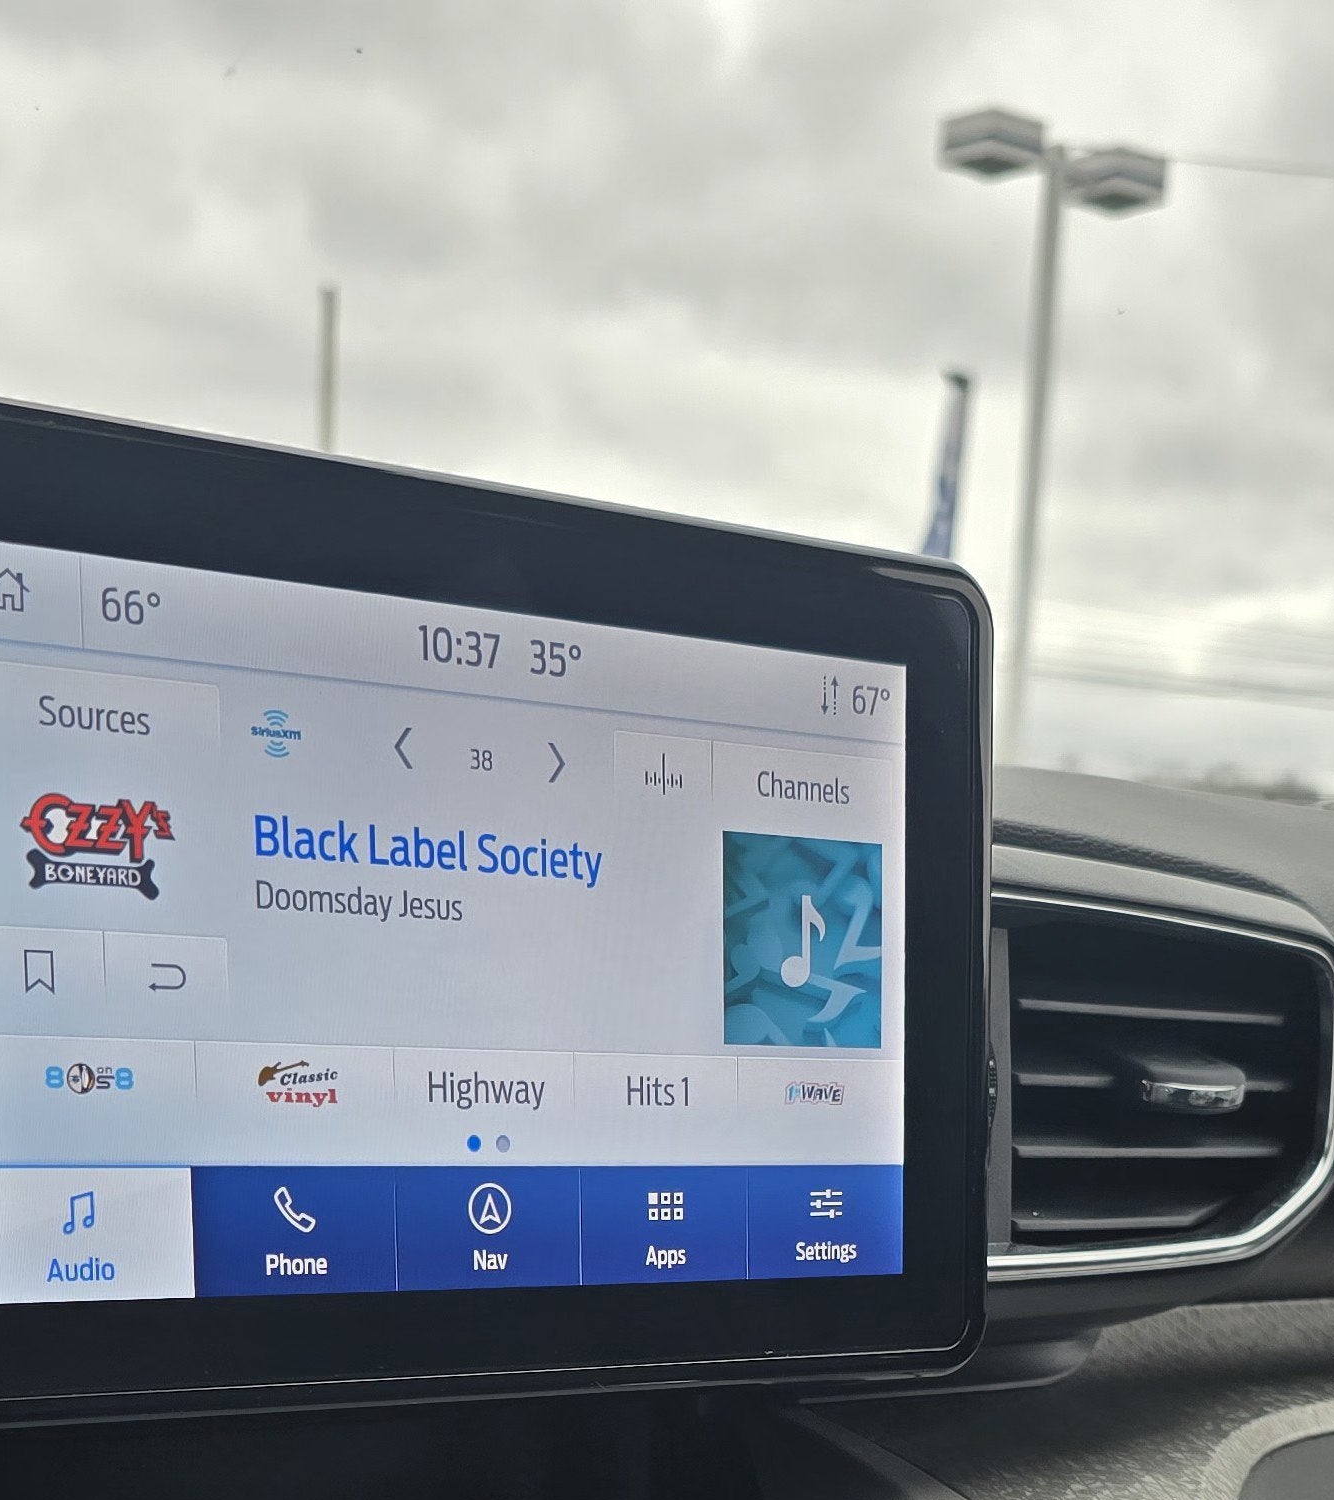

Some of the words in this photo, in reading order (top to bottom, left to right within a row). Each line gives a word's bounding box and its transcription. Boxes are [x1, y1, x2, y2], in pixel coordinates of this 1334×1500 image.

[101, 587, 161, 625] 66°
[417, 624, 501, 669] 10:37
[529, 639, 582, 678] 35°
[851, 685, 890, 717] 67°
[38, 696, 151, 736] Sources
[470, 748, 493, 772] 38
[757, 770, 850, 805] Channels
[254, 815, 359, 864] Black
[369, 824, 468, 871] Label
[477, 833, 602, 889] Society
[44, 863, 142, 887] BONEYARD
[256, 880, 393, 923] Doomsday
[399, 890, 463, 922] Jesus
[115, 1067, 134, 1090] 8
[280, 1068, 338, 1086] Classic
[266, 1088, 338, 1107] vinyl
[427, 1071, 545, 1110] Highway
[627, 1075, 675, 1106] Hits
[681, 1076, 689, 1107] 1
[265, 1254, 328, 1277] Phone
[473, 1250, 508, 1271] Nav
[645, 1245, 687, 1269] Apps
[795, 1241, 857, 1264] Settings
[47, 1258, 115, 1284] Audio
